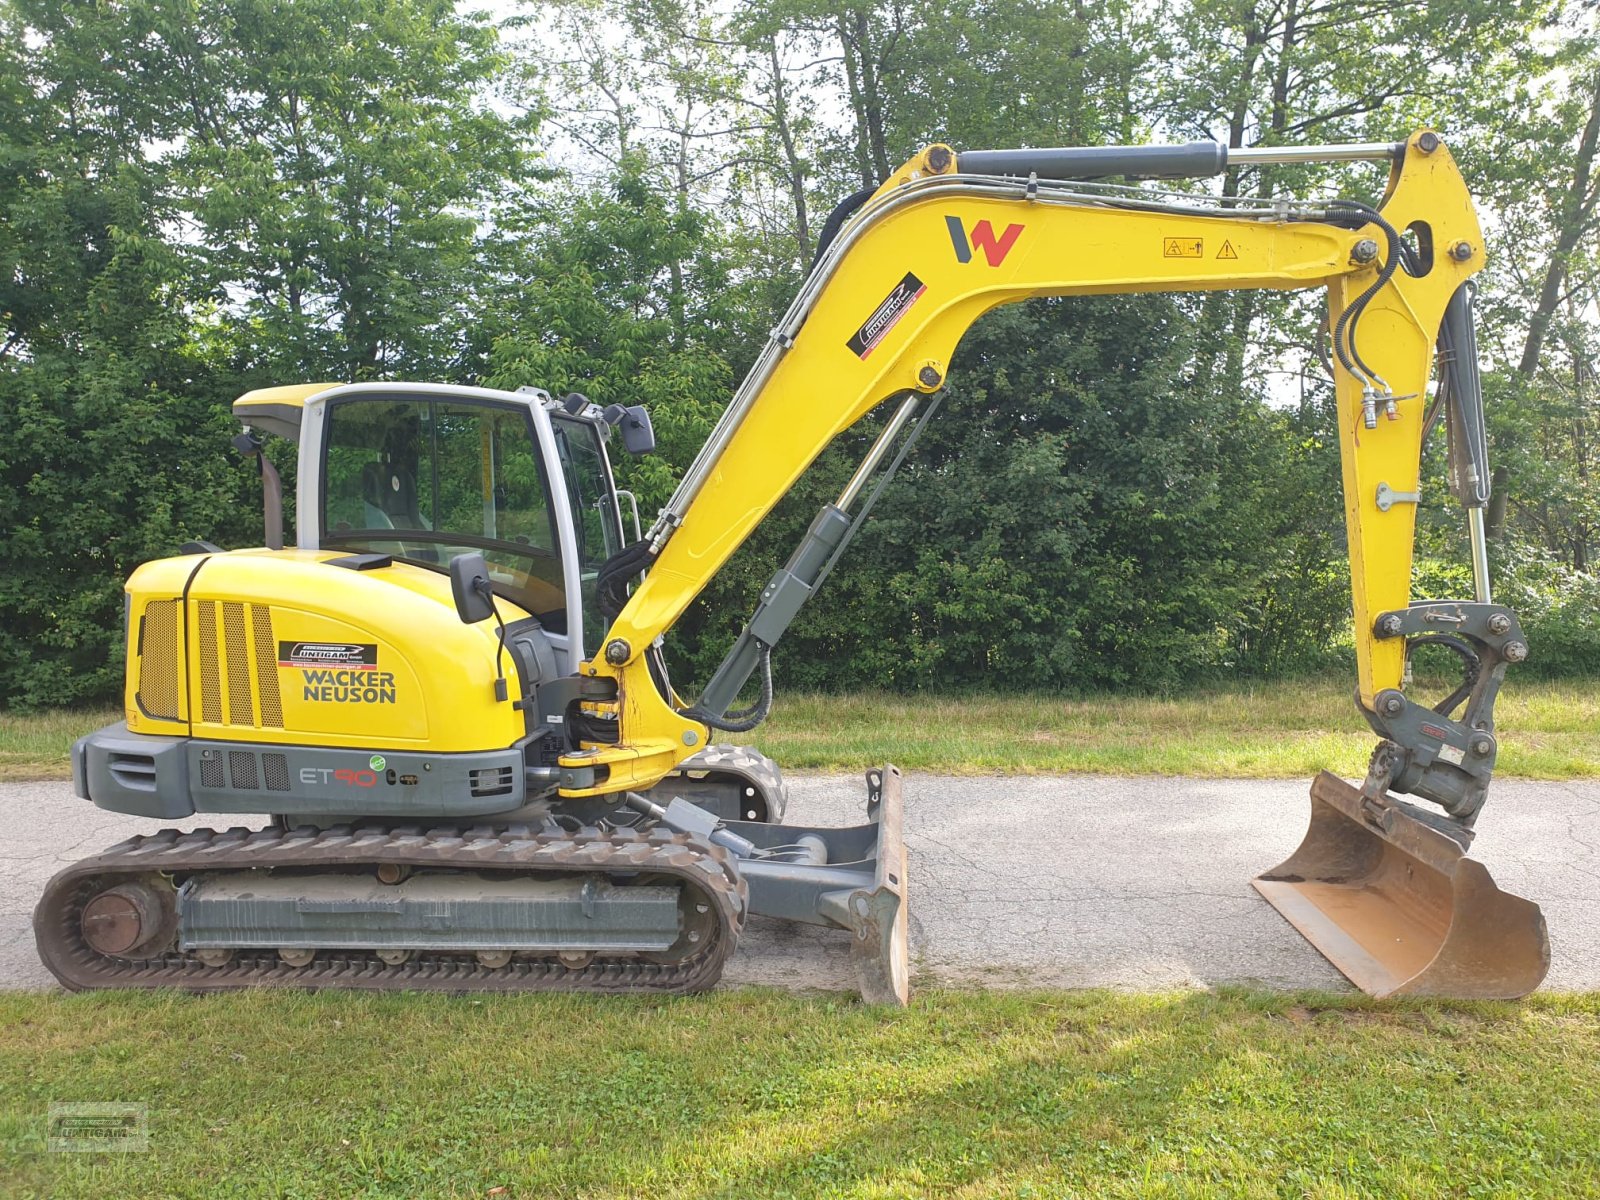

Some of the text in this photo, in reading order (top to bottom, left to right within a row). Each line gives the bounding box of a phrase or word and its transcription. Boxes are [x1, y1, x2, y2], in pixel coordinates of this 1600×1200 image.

[302, 669, 396, 688] WACKER
[303, 686, 396, 704] NEUSON
[299, 767, 378, 788] ET90
